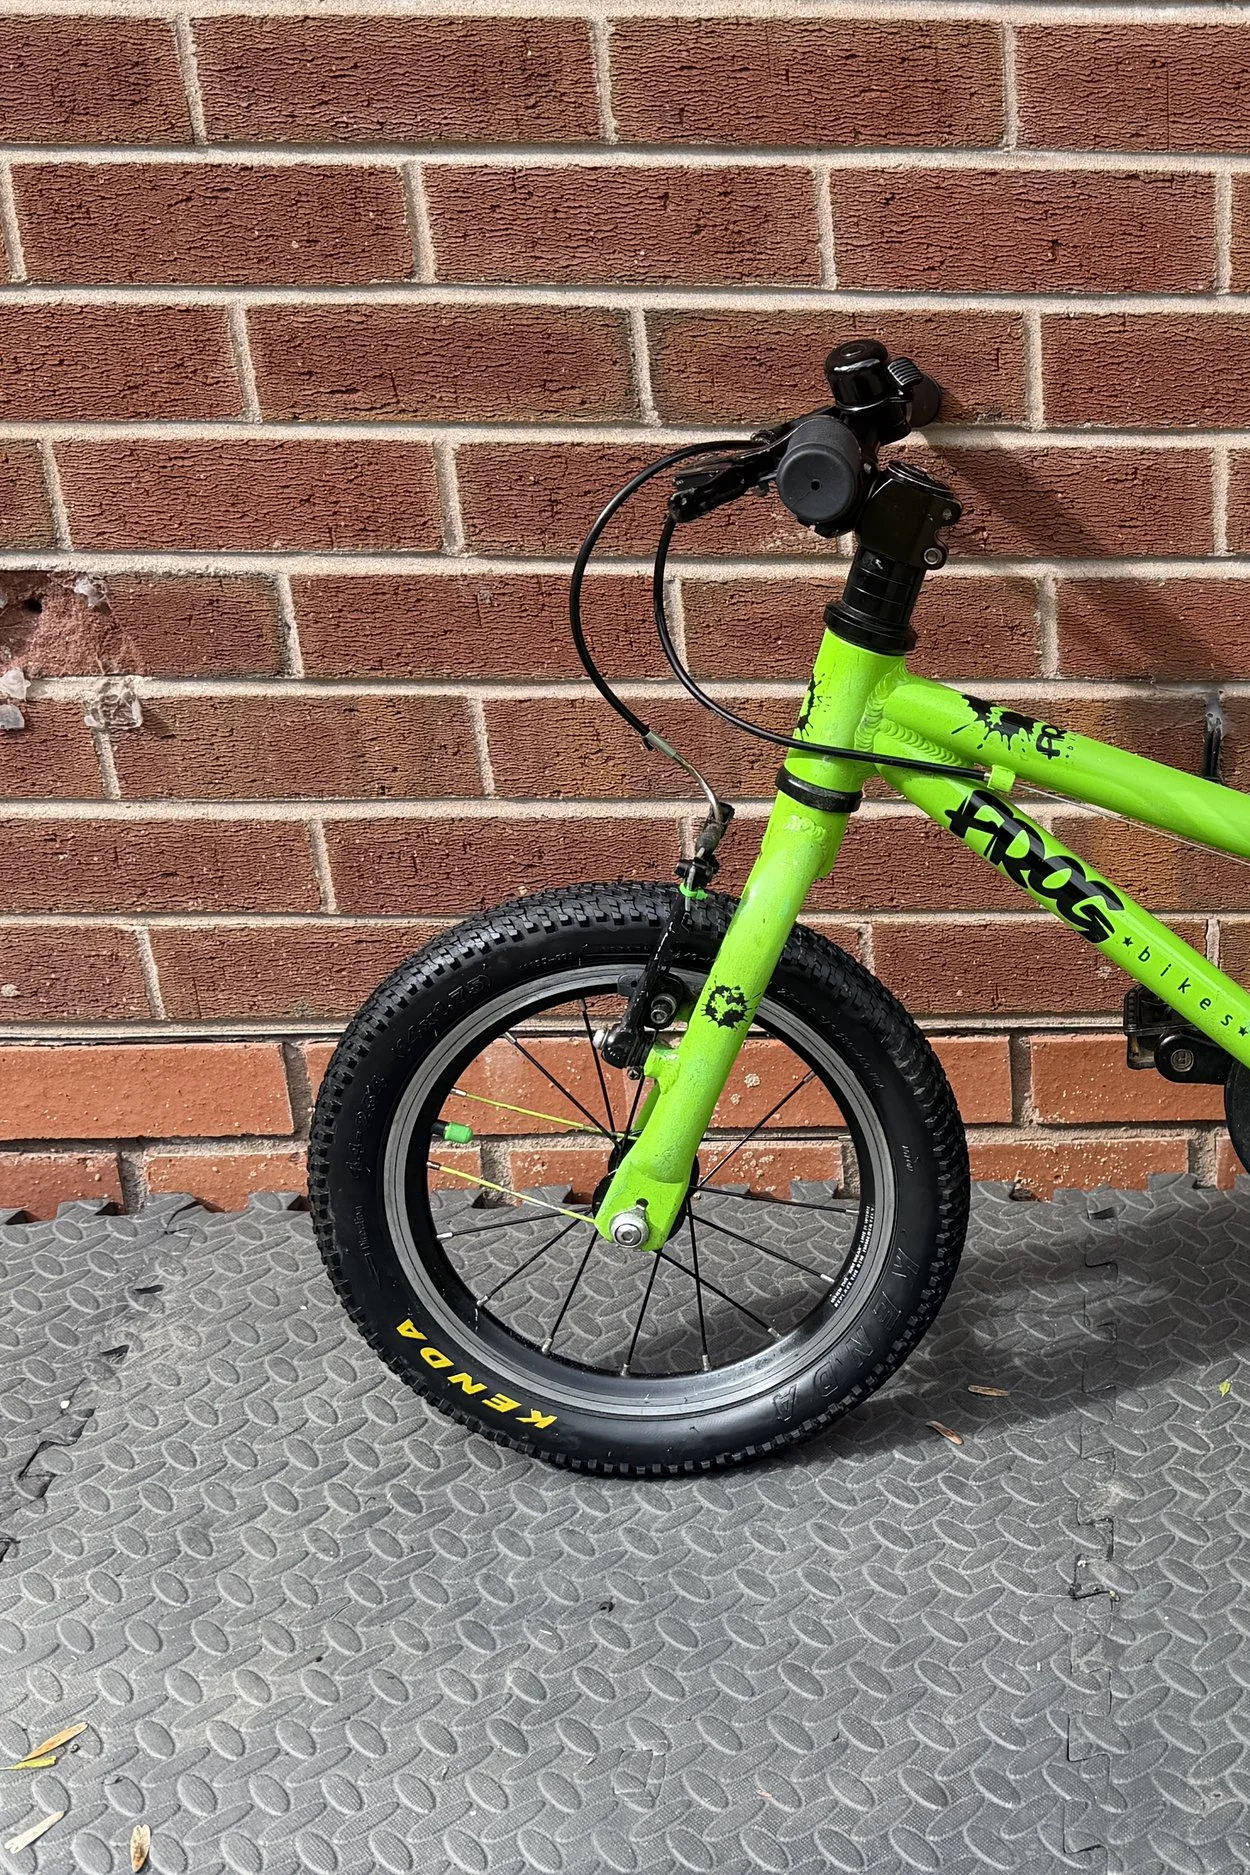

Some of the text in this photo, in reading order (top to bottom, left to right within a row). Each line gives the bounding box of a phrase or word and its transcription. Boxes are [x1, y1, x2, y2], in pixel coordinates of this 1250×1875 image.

[944, 789, 1233, 1027] FROG bikes
[395, 1318, 558, 1429] KENDA
